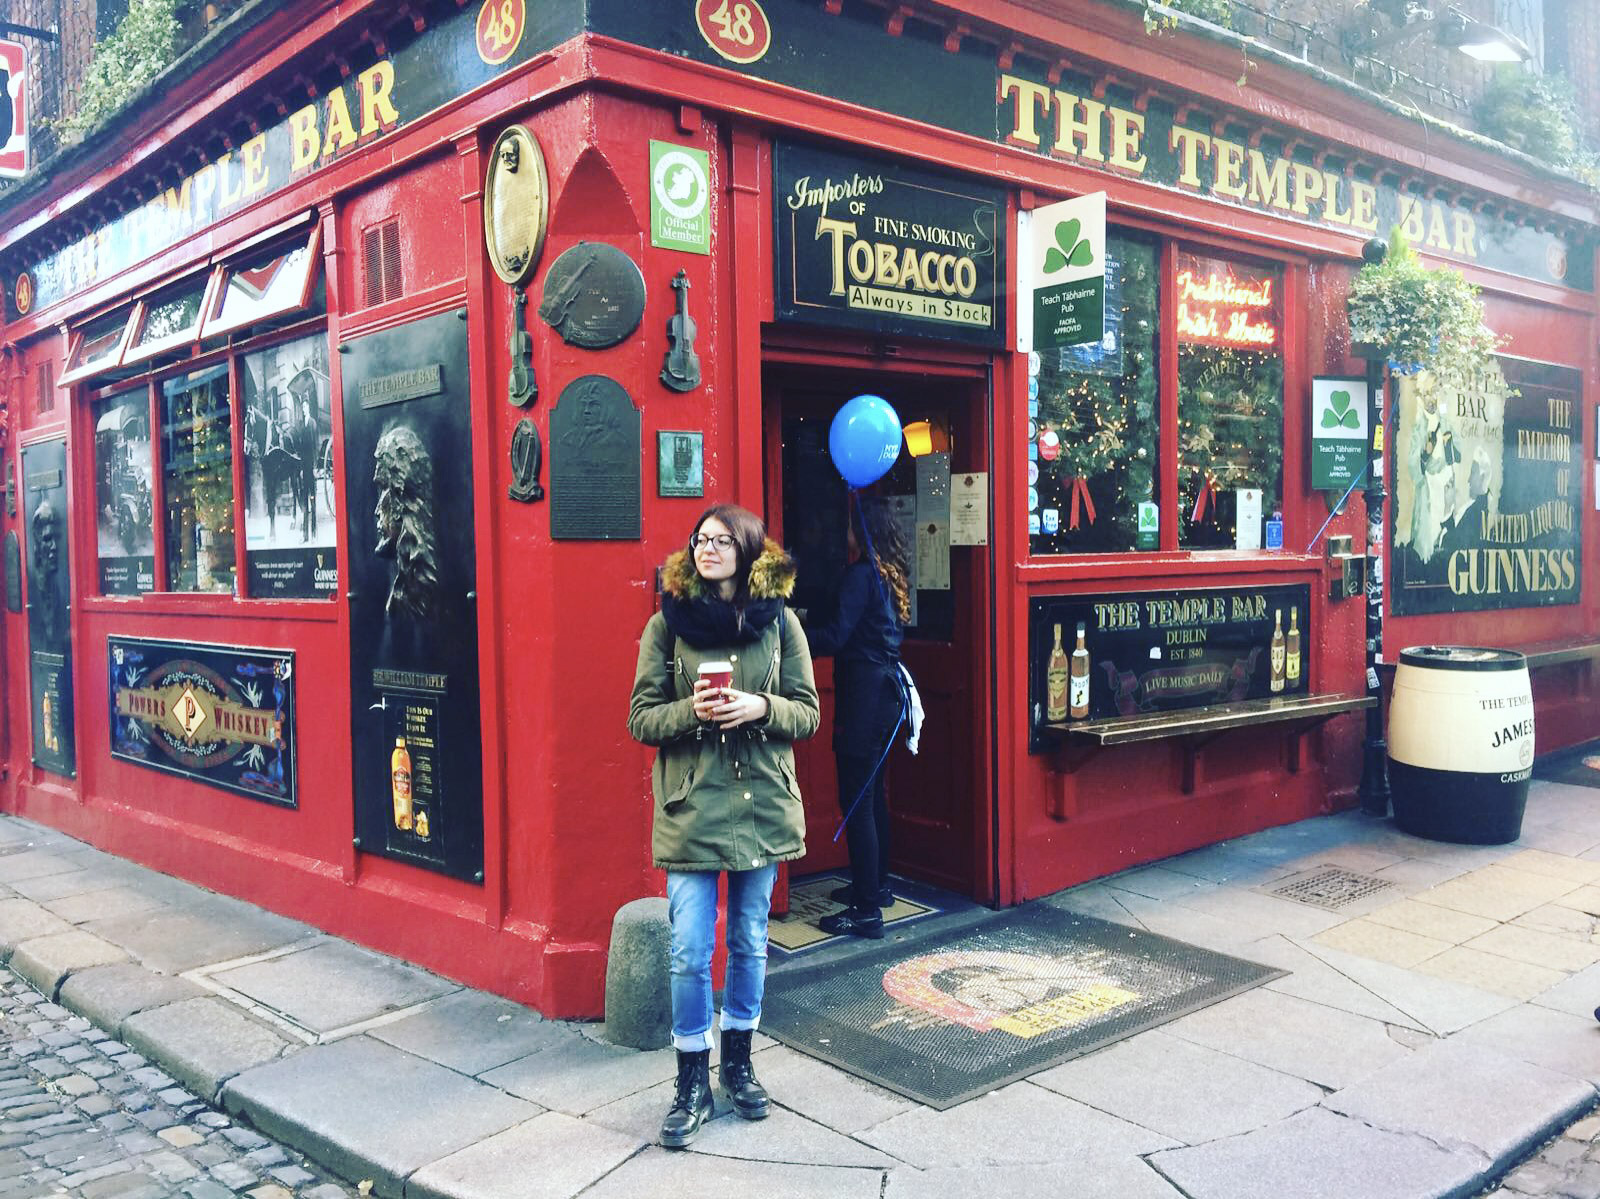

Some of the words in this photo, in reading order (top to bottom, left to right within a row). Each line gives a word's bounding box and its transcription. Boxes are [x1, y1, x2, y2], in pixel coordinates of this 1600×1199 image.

[484, 0, 516, 51] 48
[708, 0, 755, 46] 48
[123, 130, 270, 238] MPLE
[288, 60, 399, 172] BAR
[1001, 73, 1148, 173] THE
[1171, 125, 1378, 231] TEMPLE
[1398, 193, 1477, 258] BAR
[787, 173, 883, 216] Importers
[849, 201, 866, 216] OF
[662, 227, 702, 242] Member
[664, 216, 699, 230] Official
[874, 216, 908, 239] FINE
[911, 224, 977, 250] SMOKING
[814, 216, 977, 298] TOBACCO
[852, 287, 914, 312] Always
[922, 301, 937, 315] in
[944, 301, 989, 323] Stock
[1041, 292, 1061, 306] Teach
[1061, 302, 1075, 314] Pub
[1053, 323, 1082, 335] APPROVED
[1456, 393, 1489, 423] BAR
[1548, 398, 1572, 429] THE
[1319, 445, 1335, 453] Teach
[1335, 454, 1346, 462] Pub
[1518, 429, 1570, 463] EMPEROR
[1557, 469, 1569, 496] OF
[1480, 510, 1528, 543] MALTED
[1448, 548, 1576, 596] GUINNESS
[1094, 602, 1141, 631] THE
[1146, 597, 1226, 628] TEMPLE
[1232, 595, 1268, 619] BAR
[1166, 629, 1208, 646] DUBLIN
[1145, 679, 1168, 693] LIVE
[1169, 675, 1197, 688] MUSIC
[1199, 670, 1226, 685] DAILY
[128, 692, 166, 718] POWERS
[185, 696, 196, 730] P
[214, 706, 268, 737] WHISKEY
[1479, 698, 1505, 710] THE
